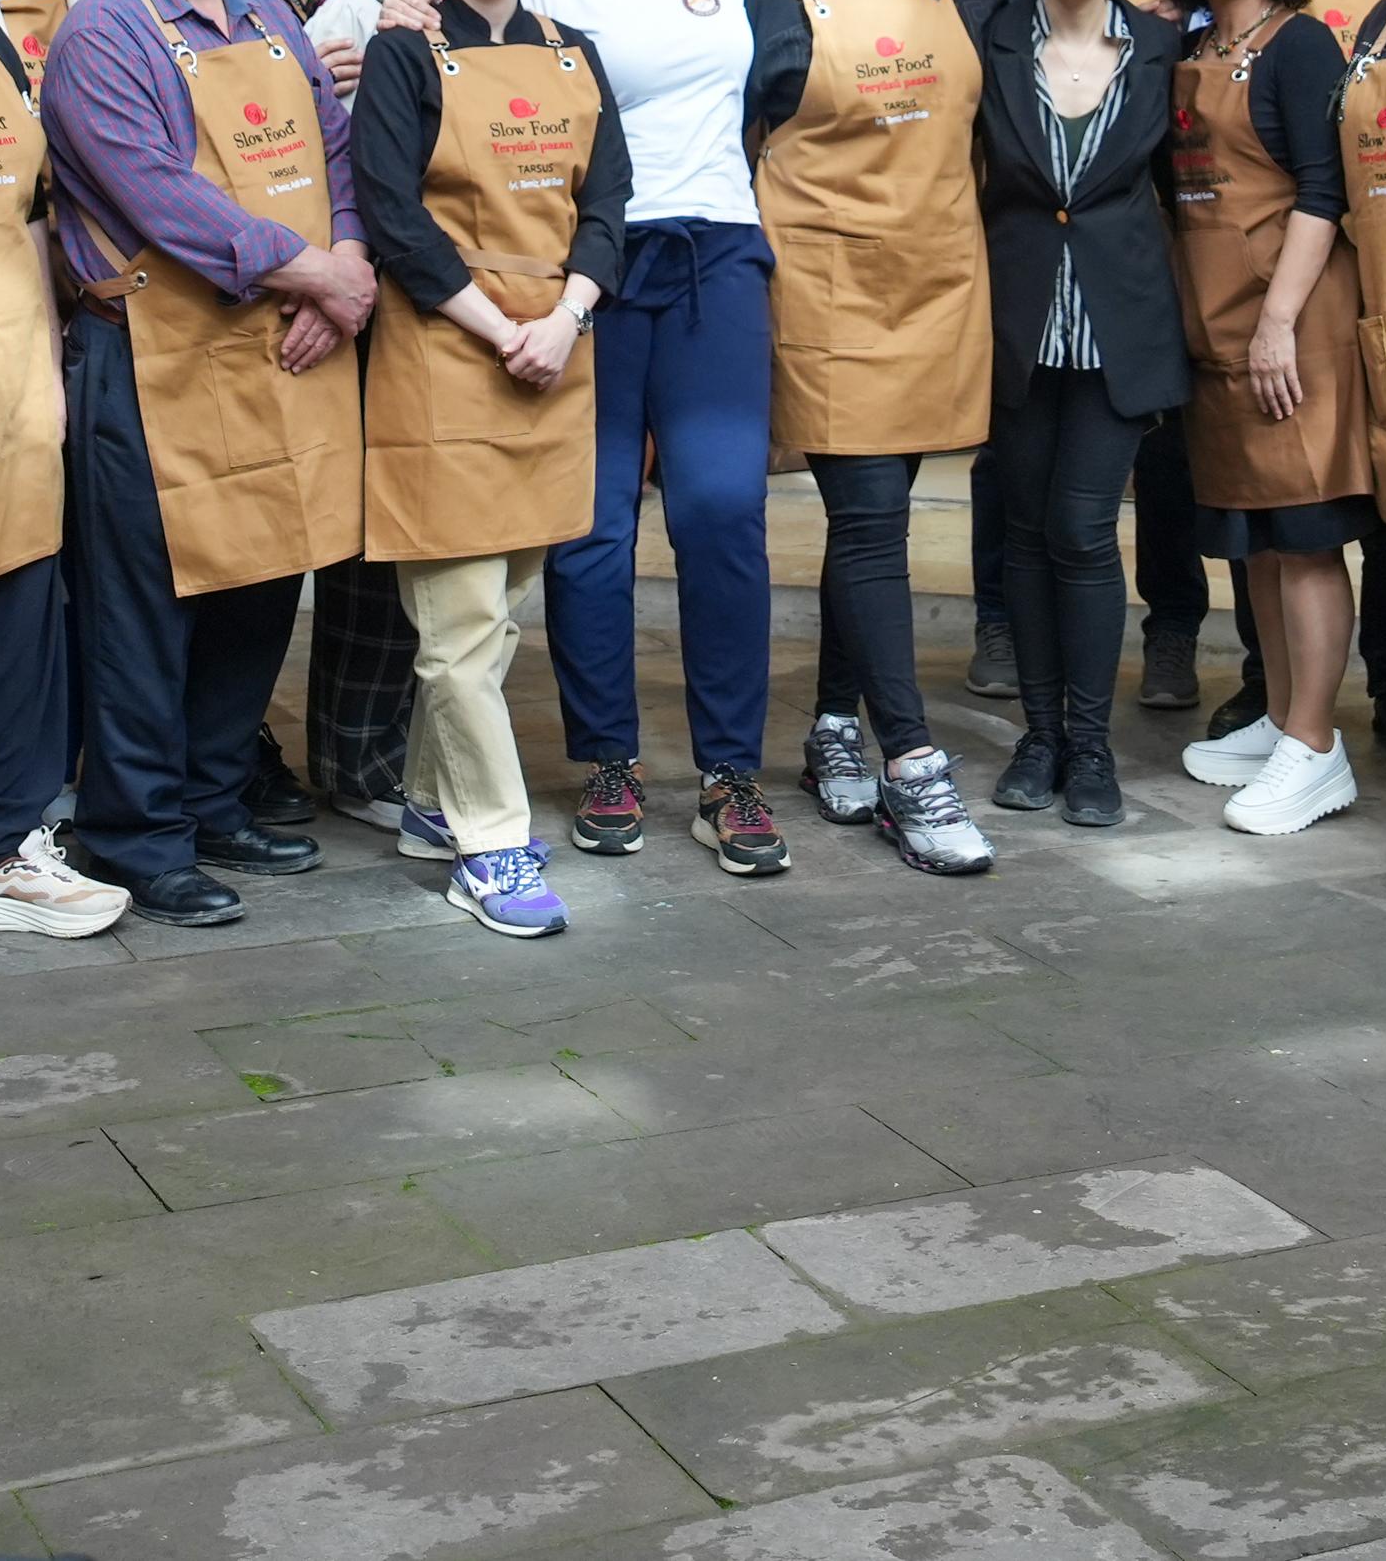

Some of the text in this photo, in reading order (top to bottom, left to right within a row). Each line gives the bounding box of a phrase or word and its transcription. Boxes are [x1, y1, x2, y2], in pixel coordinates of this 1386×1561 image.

[855, 63, 891, 79] Slow
[883, 99, 918, 111] TARSUS
[490, 122, 526, 137] Slow
[233, 132, 263, 149] Slow
[1358, 133, 1385, 148] Slow
[268, 165, 298, 179] TARSUS
[517, 163, 554, 174] TARSUS
